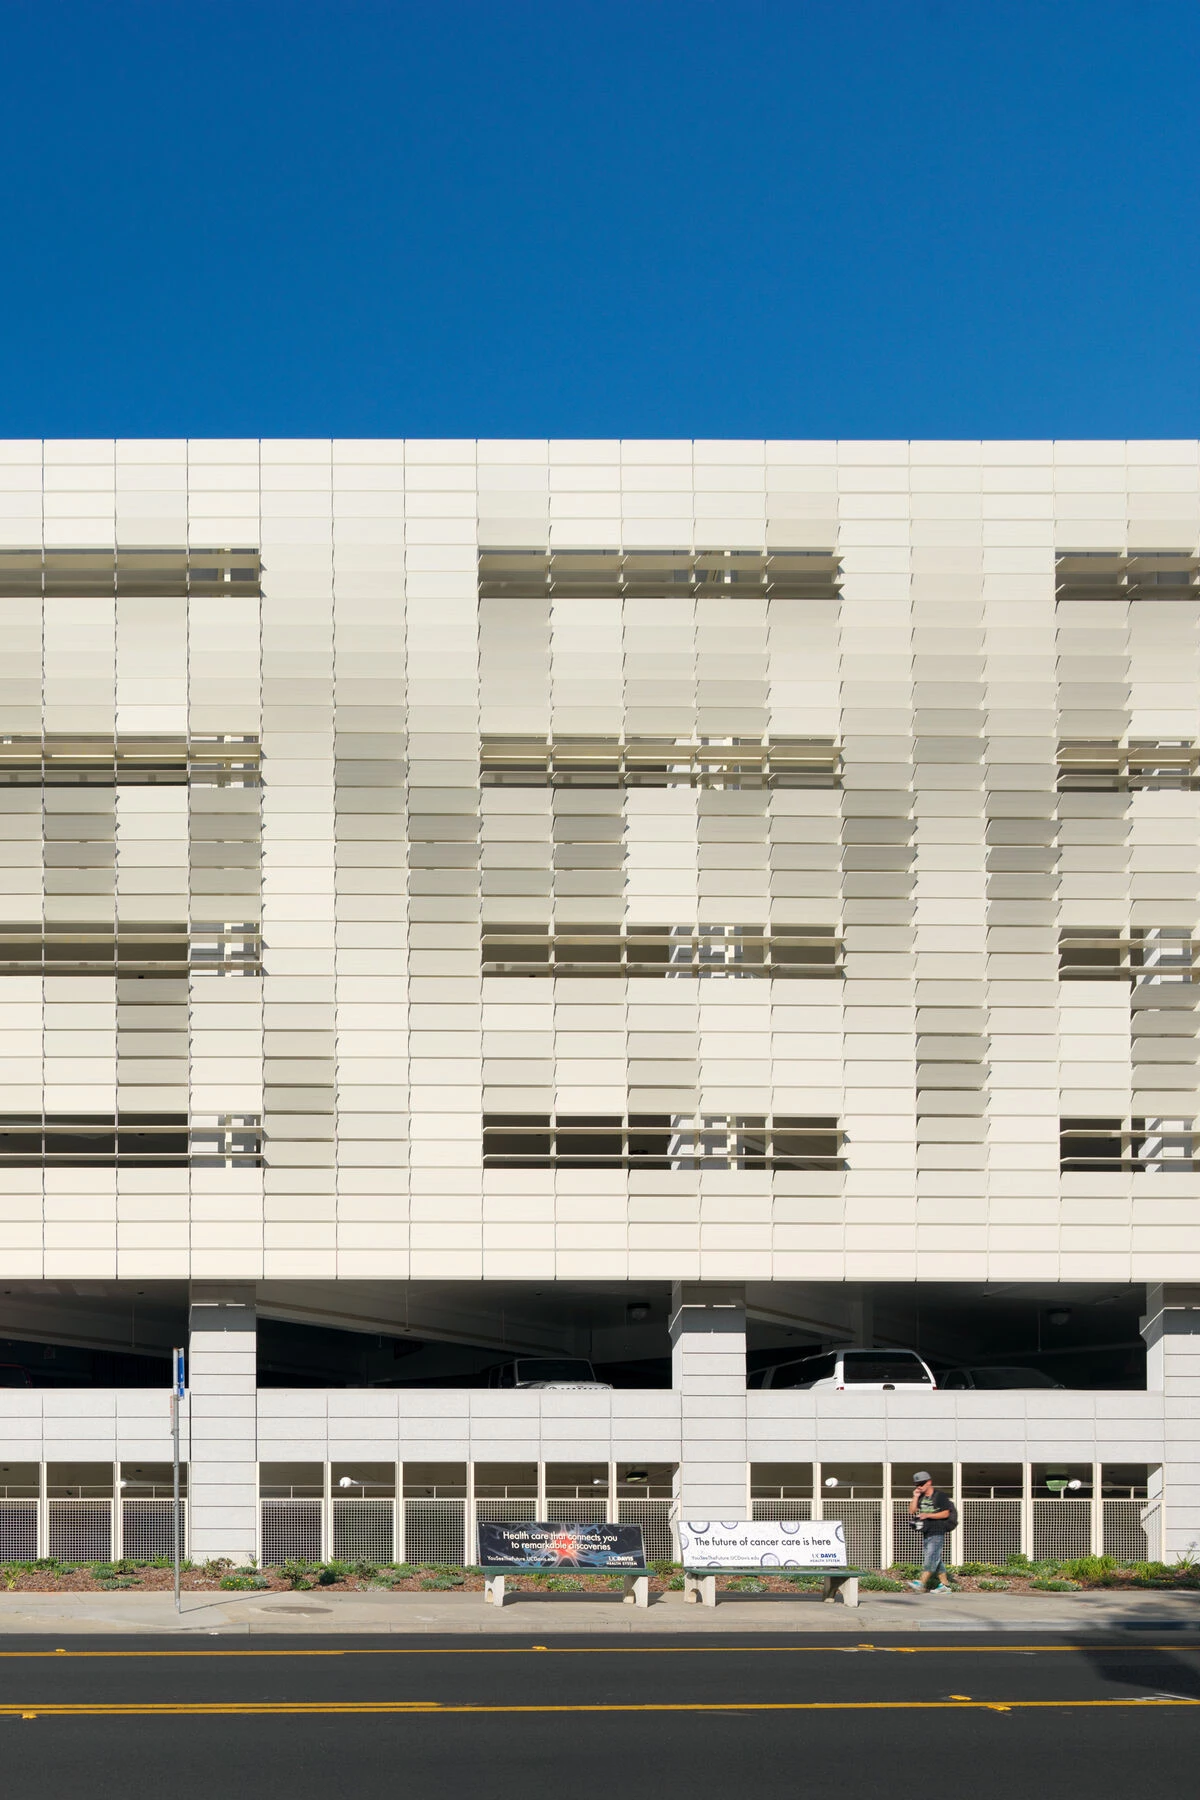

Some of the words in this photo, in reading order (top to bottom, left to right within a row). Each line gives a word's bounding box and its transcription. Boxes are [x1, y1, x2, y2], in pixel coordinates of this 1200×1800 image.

[503, 1531, 529, 1540] Health
[550, 1532, 566, 1541] that
[567, 1533, 601, 1542] connects
[603, 1535, 618, 1543] you
[694, 1537, 710, 1546] The
[712, 1537, 737, 1546] future
[739, 1537, 748, 1546] of
[803, 1537, 810, 1546] is
[812, 1537, 831, 1546] here
[511, 1541, 520, 1549] to
[521, 1541, 567, 1550] remarkable
[568, 1541, 611, 1551] discoveries
